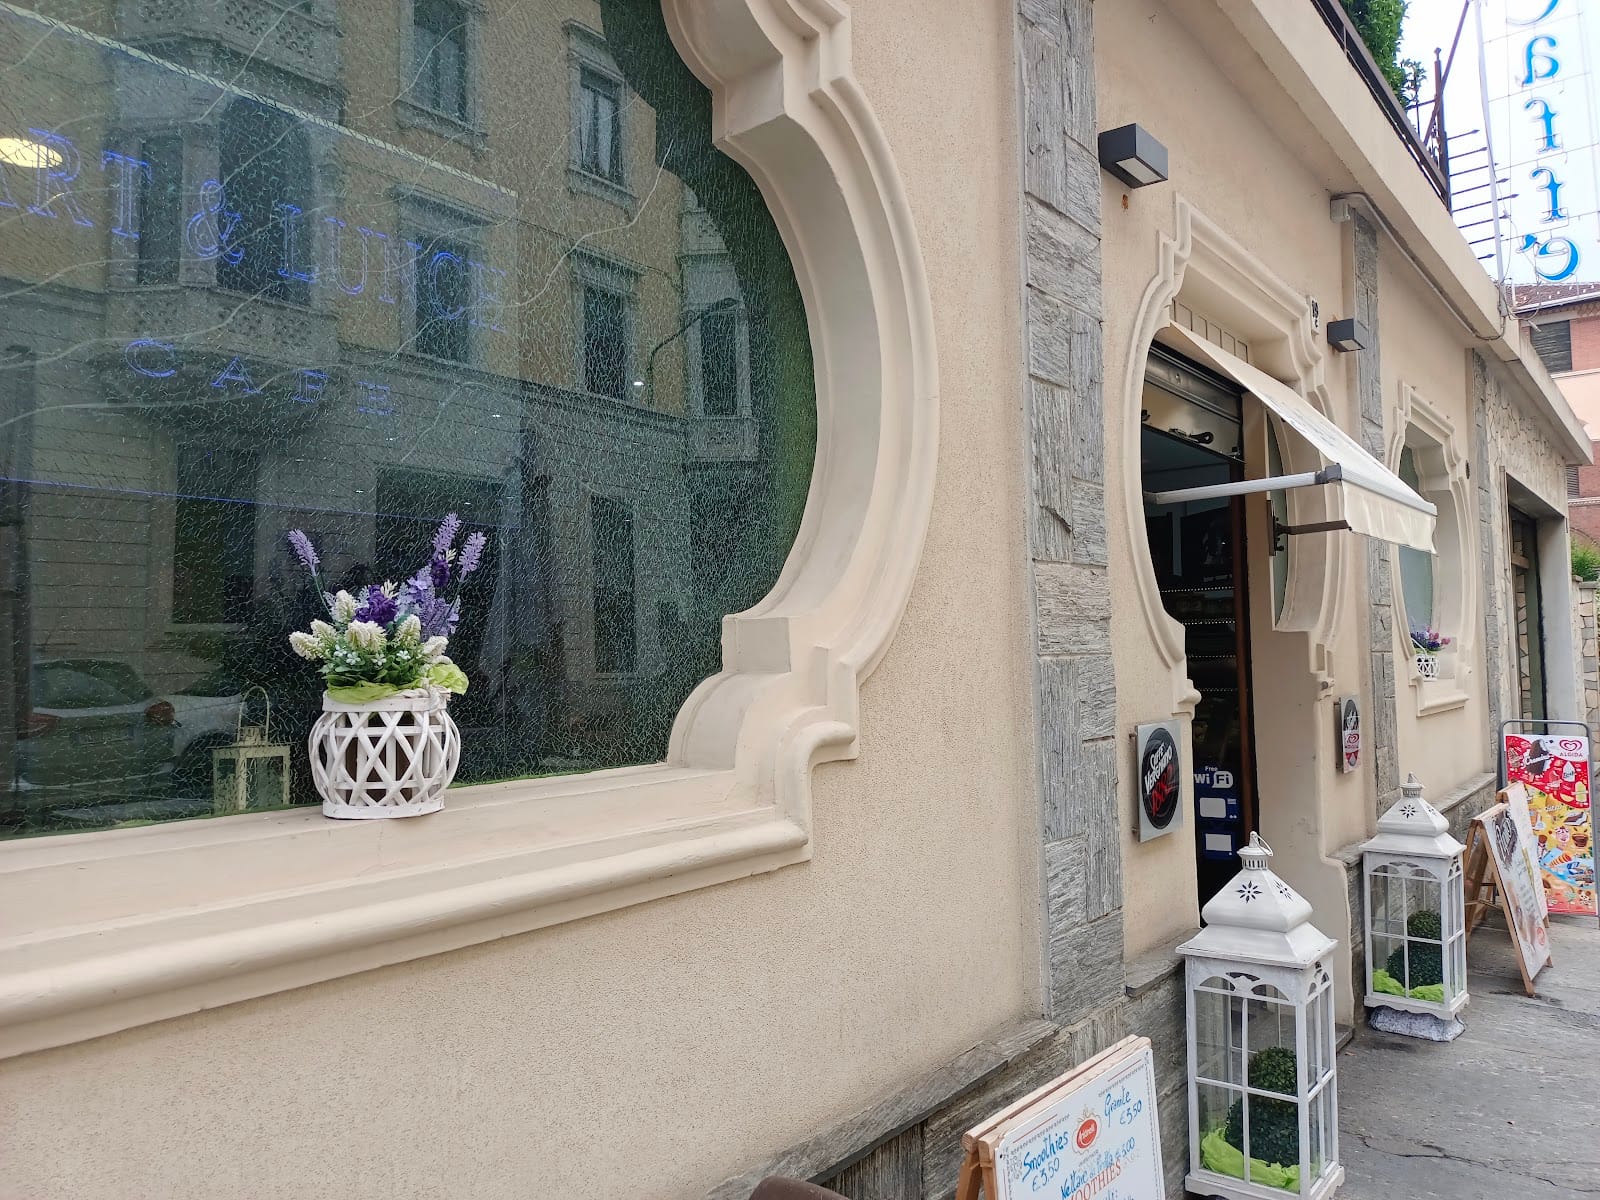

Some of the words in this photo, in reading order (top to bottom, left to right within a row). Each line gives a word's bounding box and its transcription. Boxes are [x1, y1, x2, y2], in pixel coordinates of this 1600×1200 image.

[187, 179, 244, 264] &
[274, 203, 507, 333] LUNCH
[1022, 1131, 1070, 1182] Smoothies
